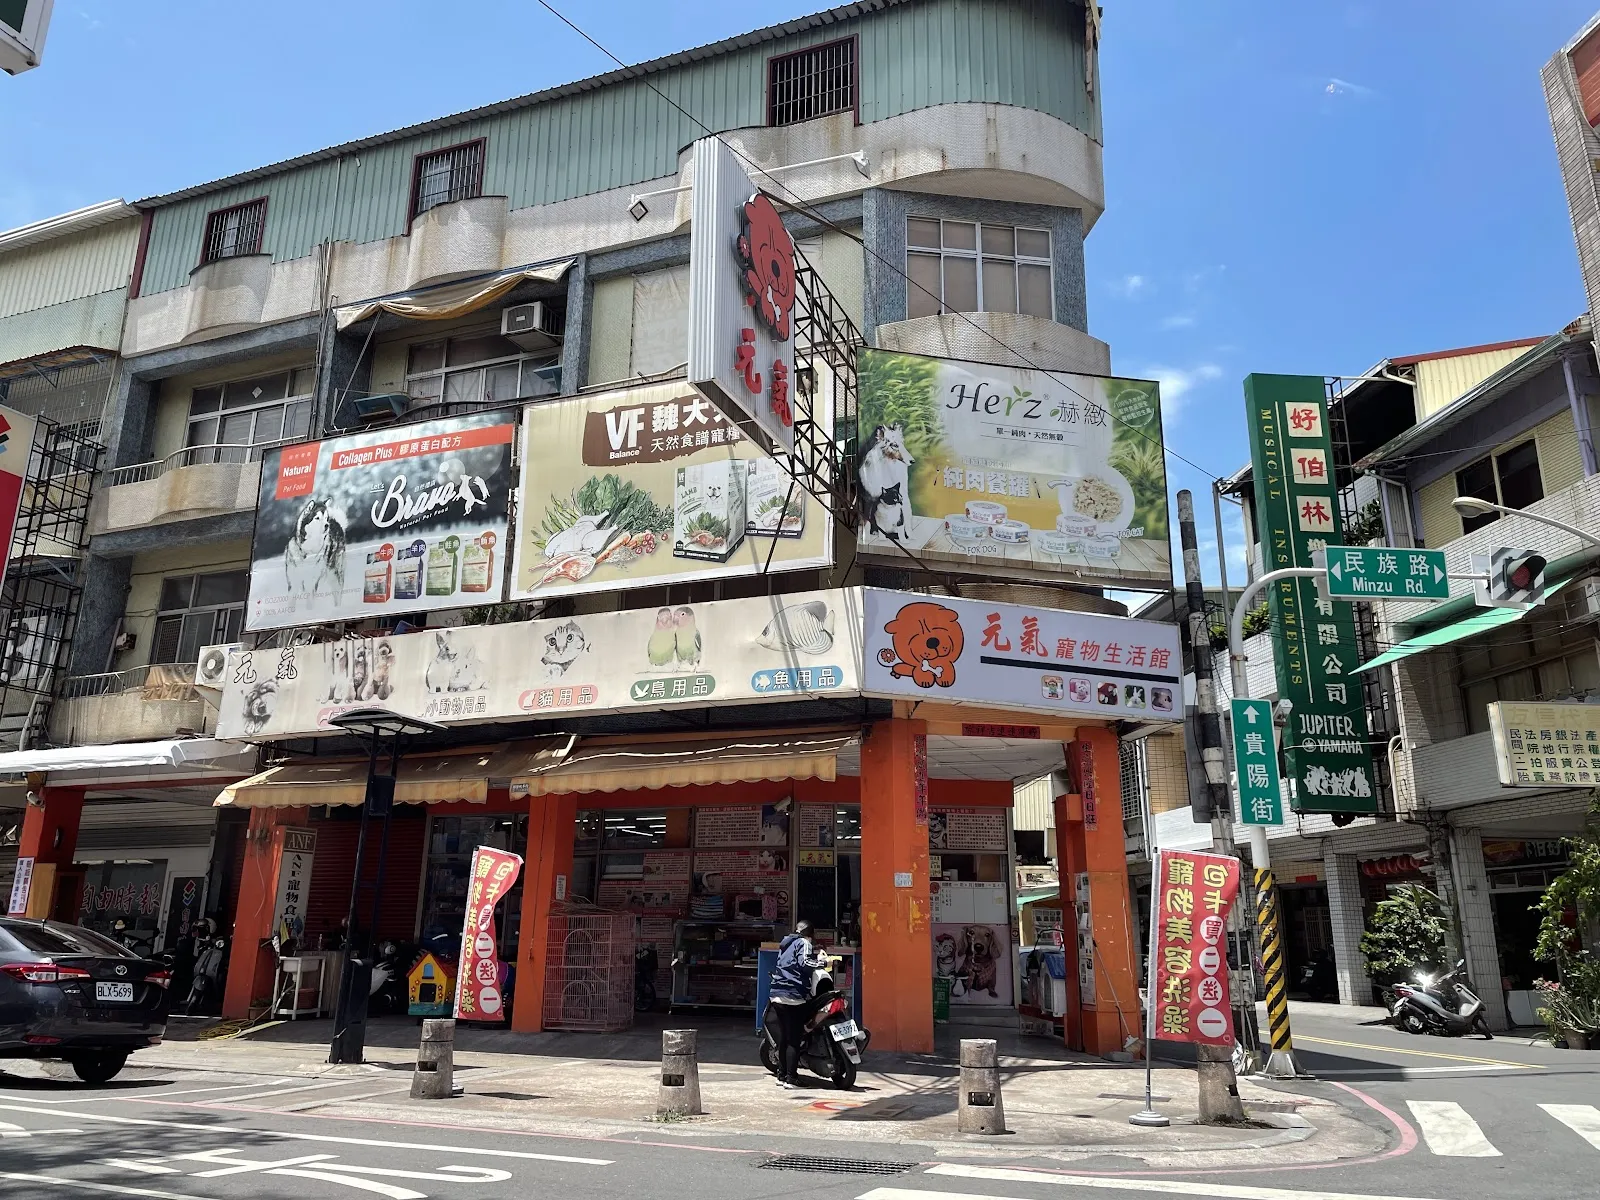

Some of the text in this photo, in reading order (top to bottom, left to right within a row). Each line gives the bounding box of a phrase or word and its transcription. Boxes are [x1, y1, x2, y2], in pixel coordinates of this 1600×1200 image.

[734, 328, 793, 427] 元氣
[946, 382, 1042, 420] Herz
[1057, 400, 1107, 427] 赫緻
[652, 398, 727, 433] 魏大
[605, 407, 645, 450] VF
[651, 426, 741, 453] 天然食譜寵糧
[338, 435, 463, 467] Collagen Plus 膠原蛋白配方
[609, 448, 640, 460] Balance
[1260, 408, 1281, 500] MUSICAL
[283, 463, 312, 477] Natural
[283, 482, 307, 493] Pet Food
[370, 482, 385, 490] Let's
[371, 474, 456, 528] Bravo
[379, 548, 393, 557] 牛肉
[411, 543, 425, 552] 羊肉
[967, 545, 997, 554] FOR DOG
[1344, 551, 1431, 577] 民族路
[1353, 577, 1427, 594] Minzu Rd.
[1274, 529, 1303, 685] INSRUMENTS
[981, 612, 1172, 669] 元氣 寵物生活館
[234, 647, 298, 684] 元氣
[773, 667, 836, 689] 魚用品
[537, 686, 593, 708] 貓用品
[650, 677, 709, 698] 鳥用品
[424, 695, 487, 718] 小動物用品
[1299, 713, 1356, 738] JUPITER
[1316, 739, 1364, 755] YAMAHA
[1245, 733, 1273, 823] 貴陽街
[288, 834, 312, 850] ANF
[80, 882, 161, 915] 自由時報
[97, 986, 132, 997] BLX-5699
